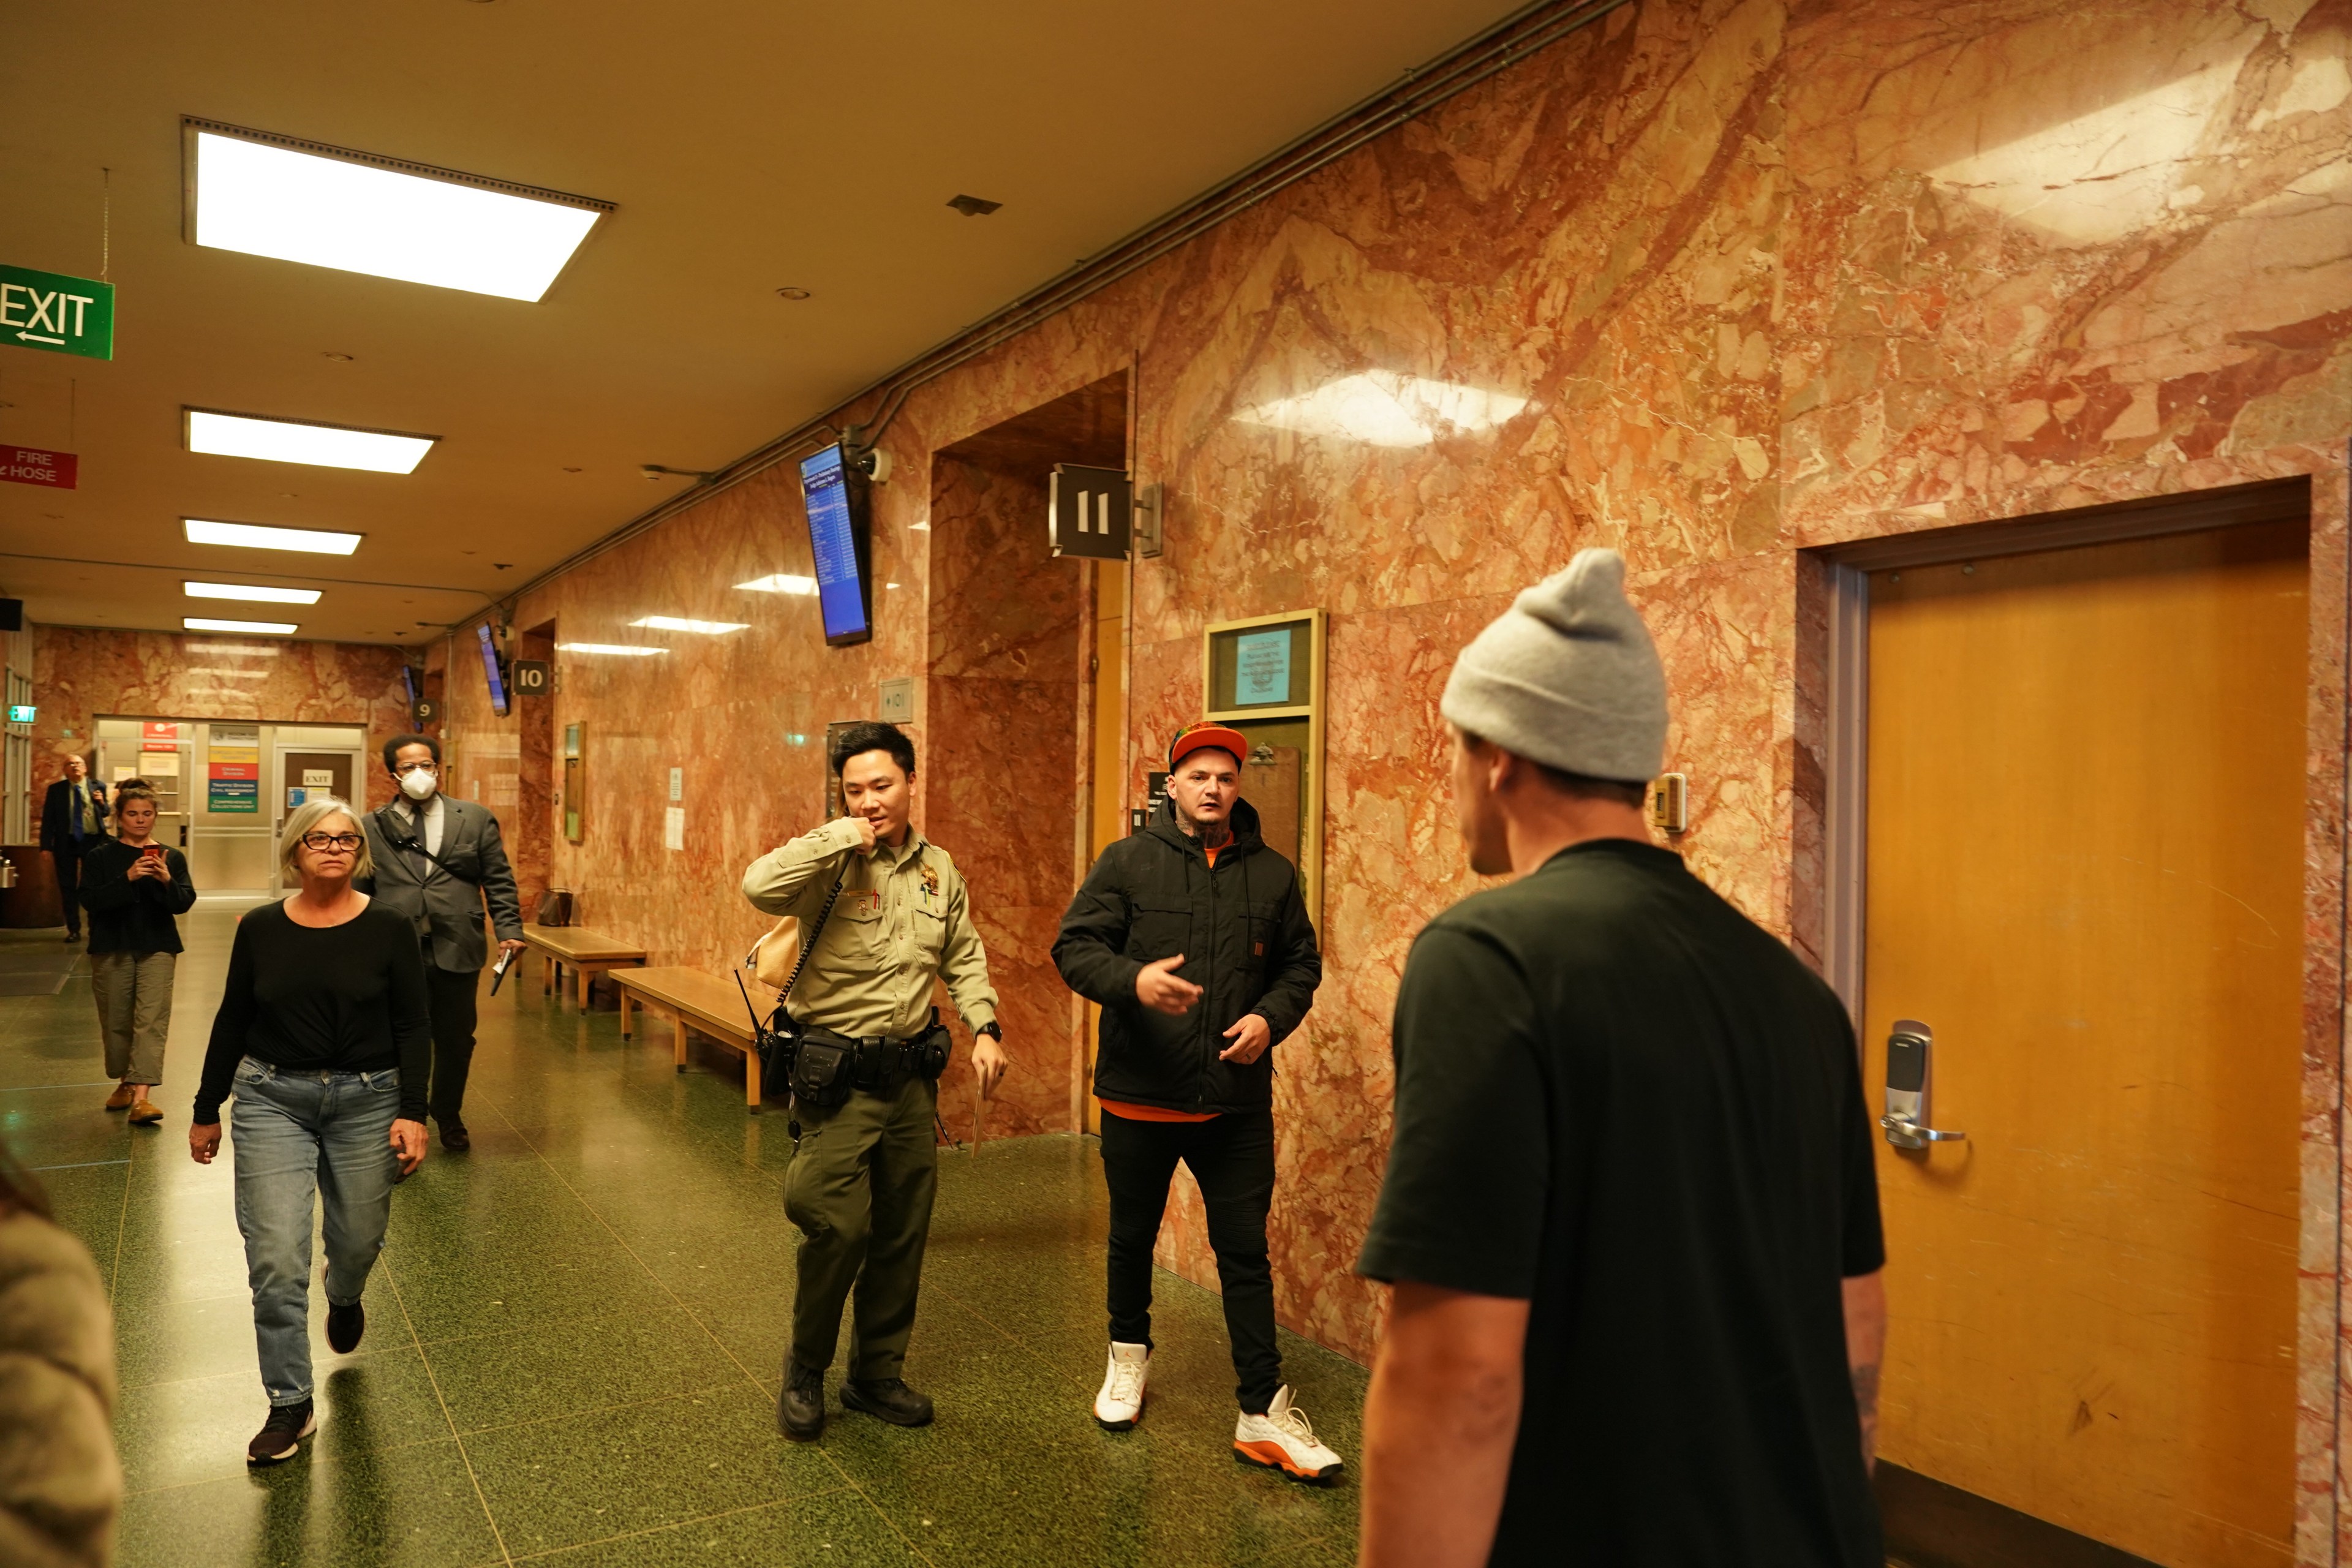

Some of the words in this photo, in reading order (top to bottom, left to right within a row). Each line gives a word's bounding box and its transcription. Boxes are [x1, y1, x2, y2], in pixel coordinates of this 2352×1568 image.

[1, 284, 93, 336] EXIT
[17, 451, 52, 466] FIRE
[10, 465, 57, 482] HOSE
[1077, 490, 1109, 535] 11
[520, 669, 543, 687] 10
[10, 706, 37, 722] EXIT
[419, 704, 431, 717] 9
